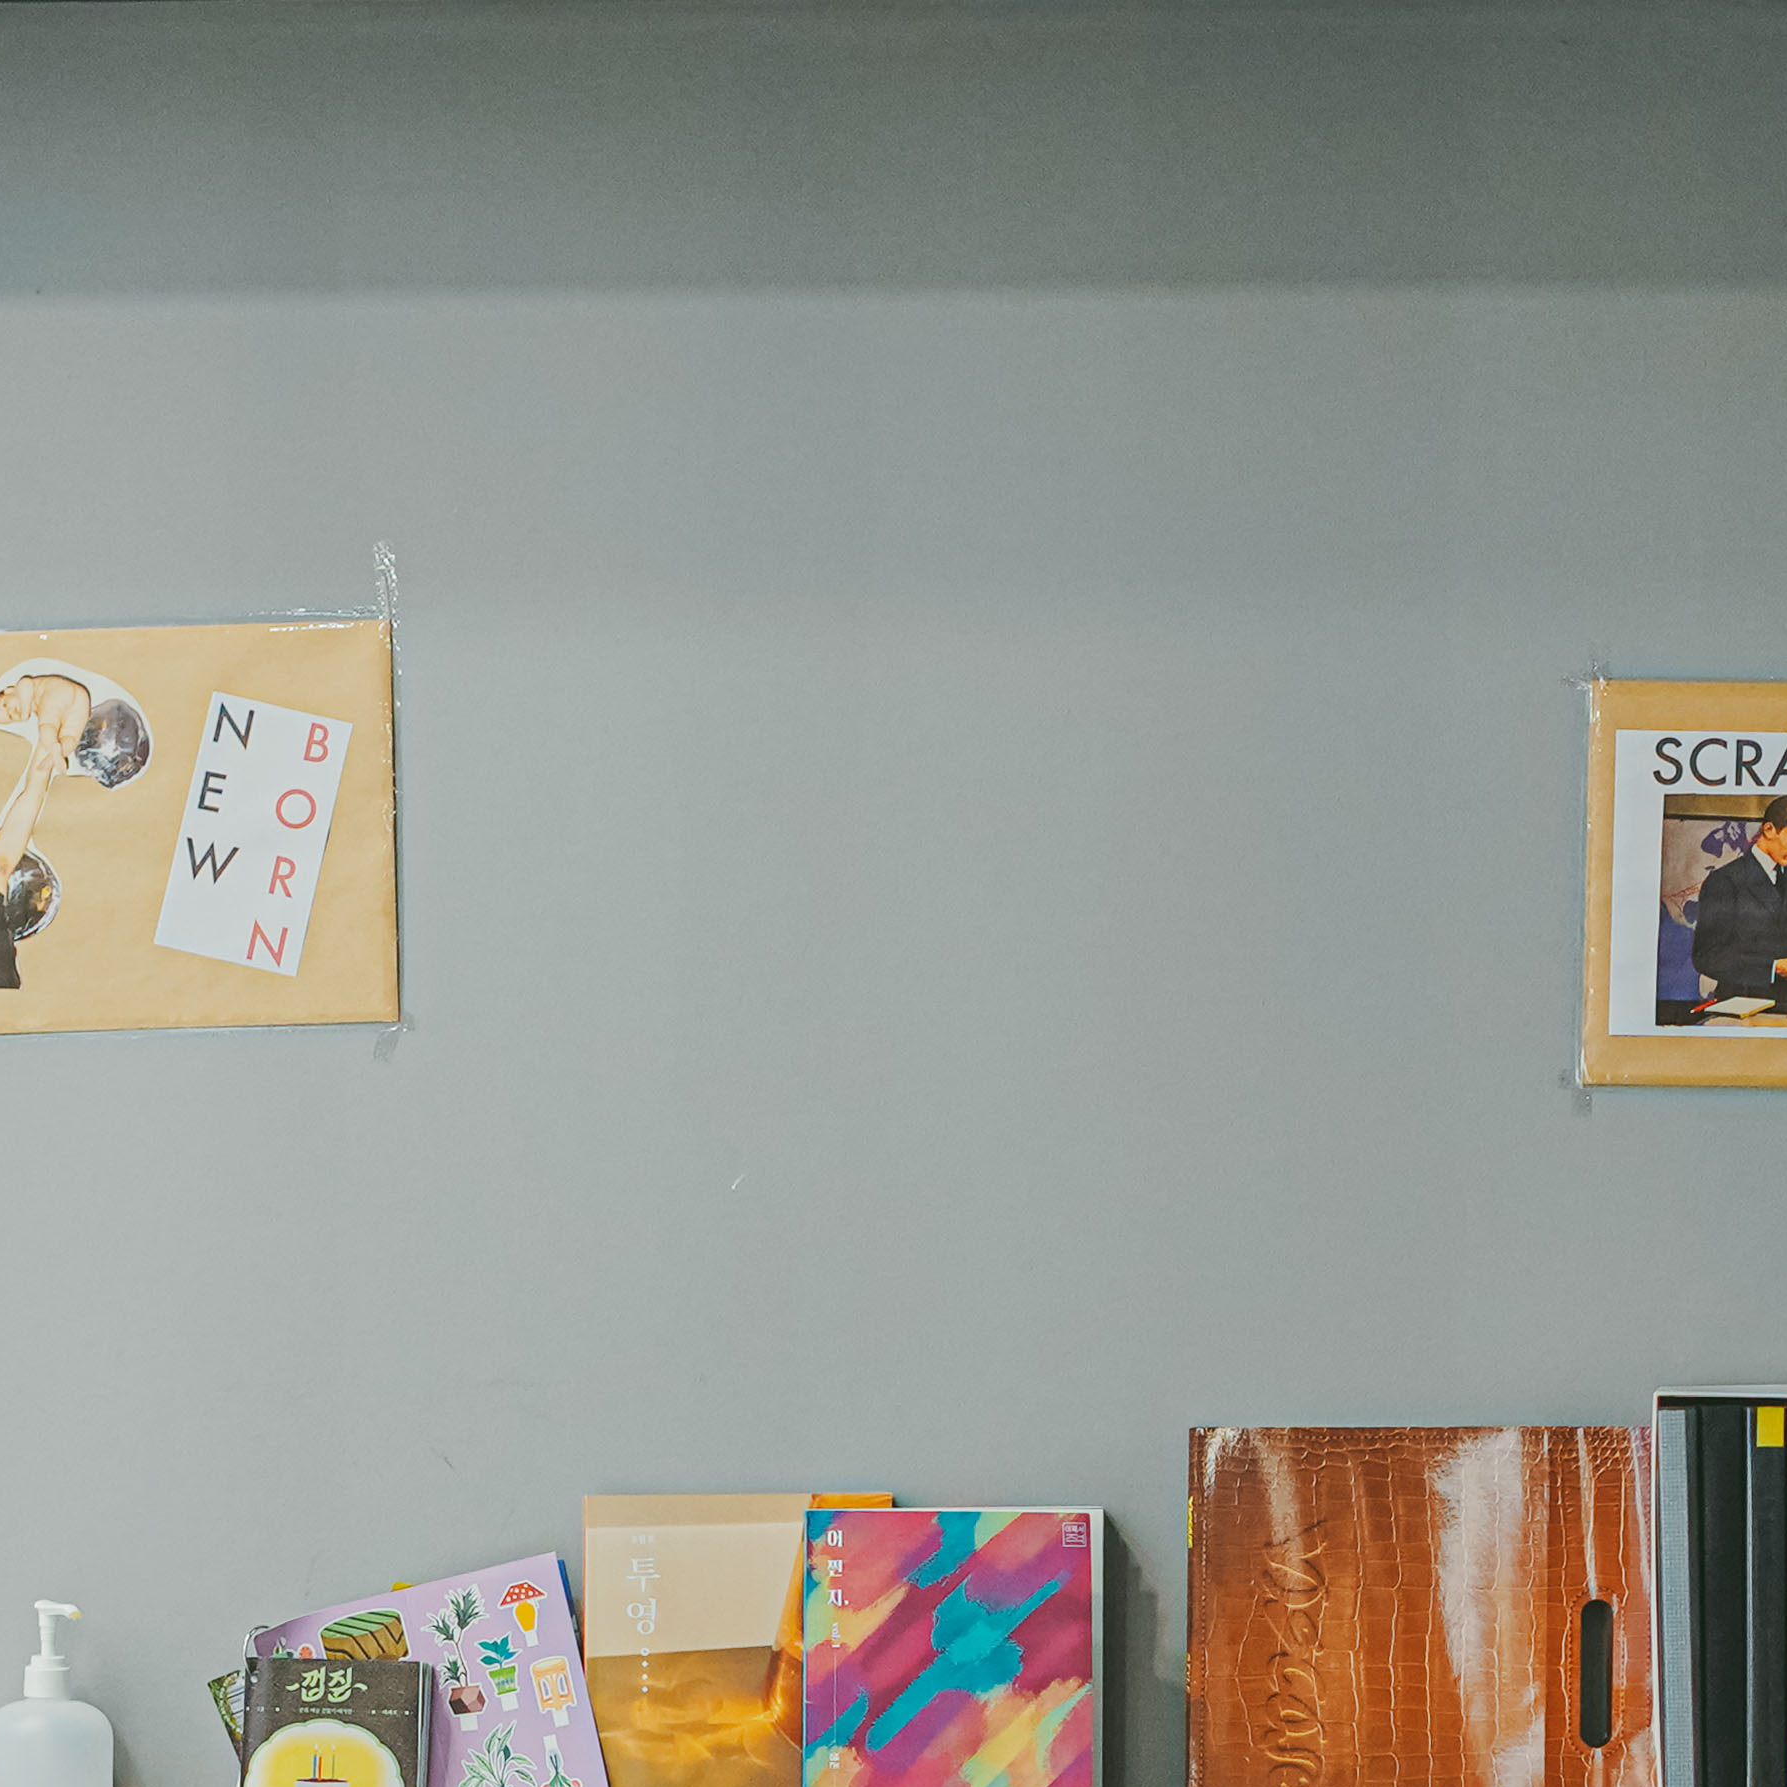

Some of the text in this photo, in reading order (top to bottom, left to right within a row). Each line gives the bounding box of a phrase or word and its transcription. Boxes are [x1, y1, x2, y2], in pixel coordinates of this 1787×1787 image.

[186, 703, 255, 884] NEW
[247, 722, 330, 968] BORN
[625, 1557, 662, 1635] 투영
